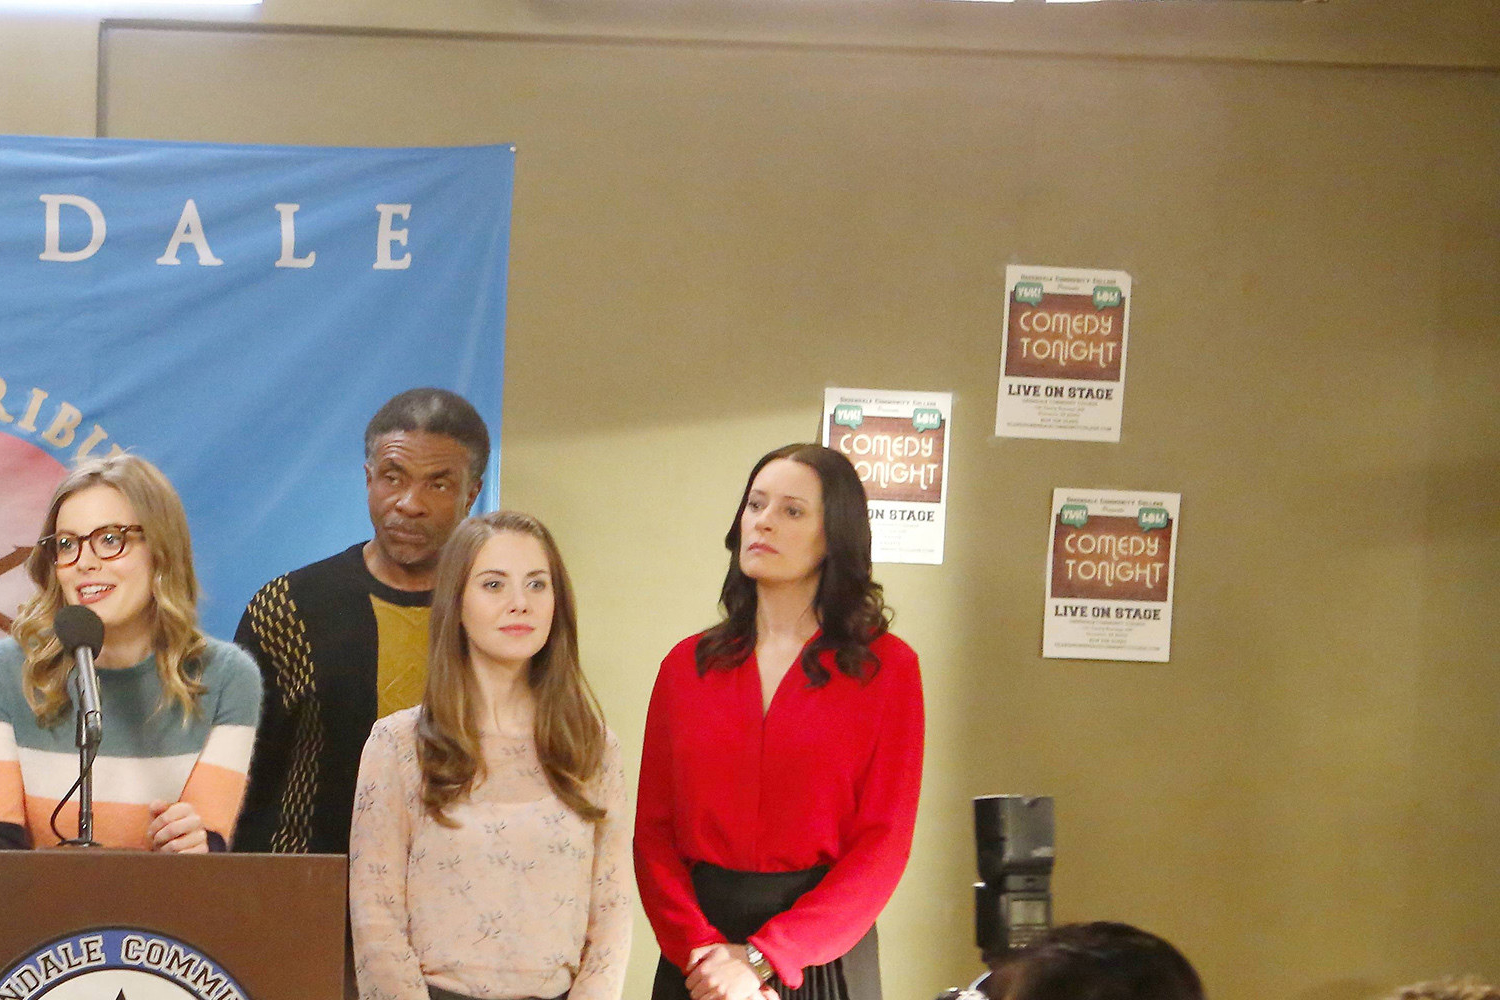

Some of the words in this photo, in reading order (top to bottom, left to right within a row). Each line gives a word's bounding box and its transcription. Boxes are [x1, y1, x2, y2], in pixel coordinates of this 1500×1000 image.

[1020, 311, 1113, 339] COMEDY
[1020, 338, 1117, 368] TONIGHT
[1008, 384, 1041, 397] LIVE
[1045, 385, 1064, 398] ON
[1068, 386, 1114, 400] STAGE
[840, 433, 934, 462] COMEDY
[855, 460, 939, 490] ONIGHT
[890, 509, 935, 522] STAGE
[1065, 533, 1160, 561] COMEDY
[1065, 559, 1164, 588] TONIGHT
[1054, 605, 1088, 617] LIVE
[1092, 607, 1111, 618] ON
[1115, 608, 1161, 620] STAGE
